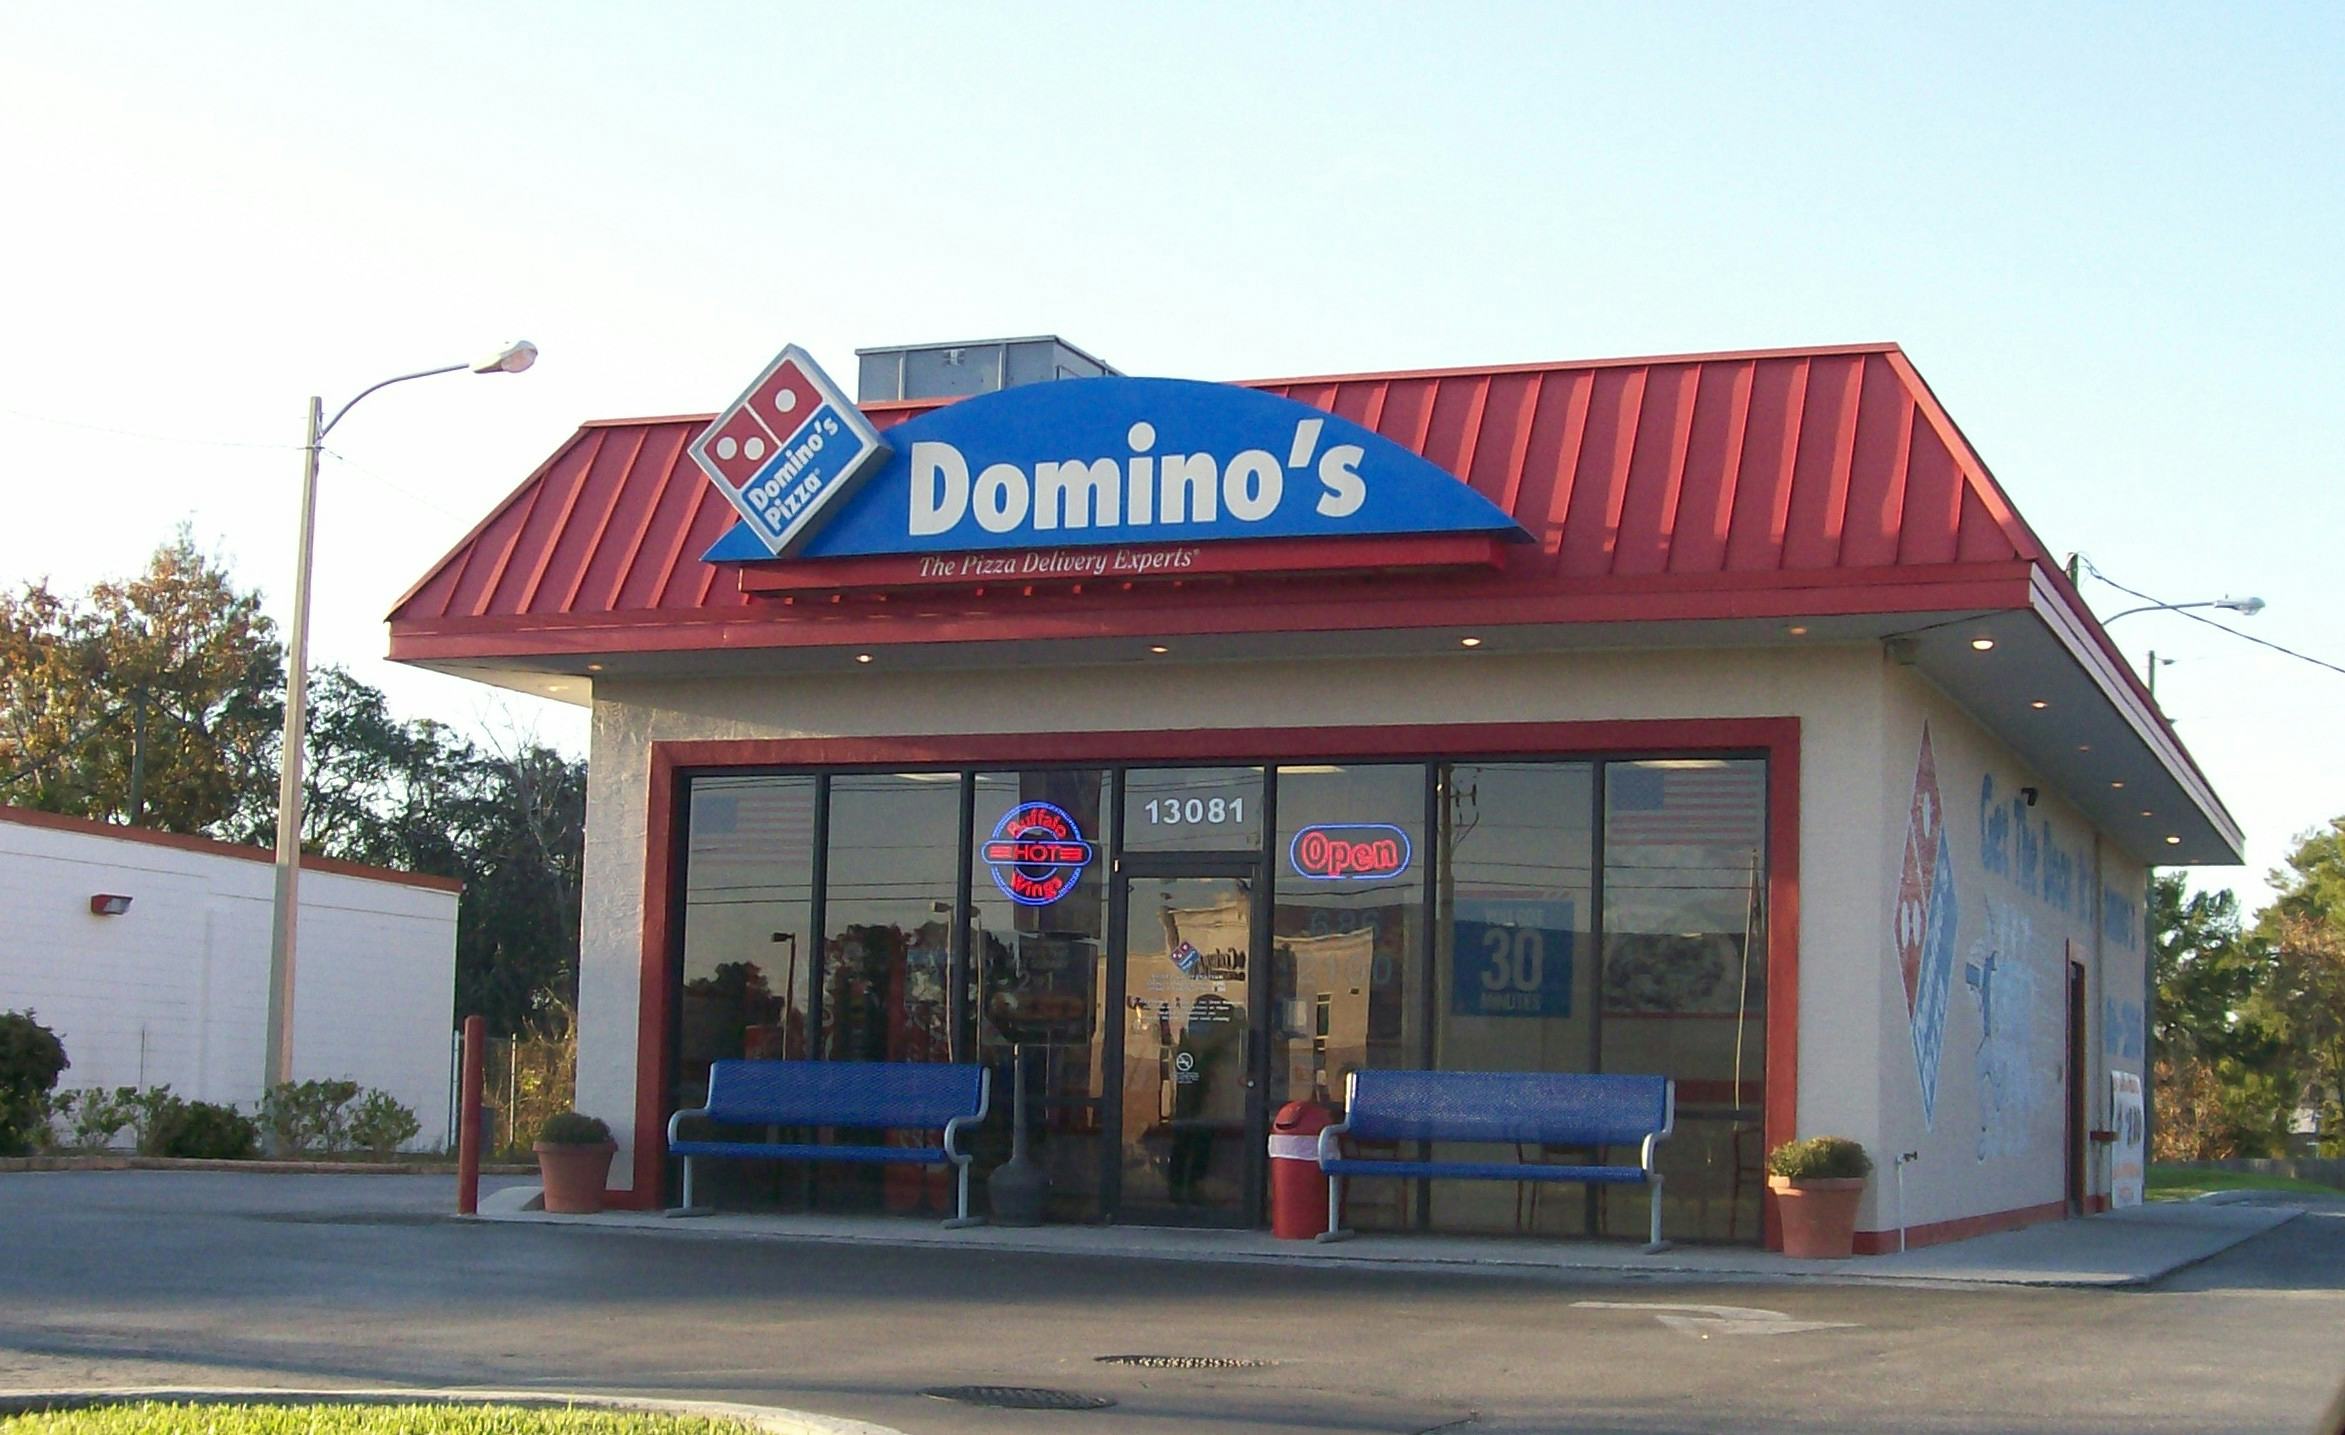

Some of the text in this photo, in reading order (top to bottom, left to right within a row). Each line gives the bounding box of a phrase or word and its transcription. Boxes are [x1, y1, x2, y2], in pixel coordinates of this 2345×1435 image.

[748, 416, 839, 512] Domino's
[908, 417, 1368, 536] Domino's
[764, 472, 823, 531] Pizza
[919, 547, 1194, 578] The Pizza Delivery Experts
[1006, 807, 1068, 838] Buffalo
[1144, 798, 1245, 825] 13081
[1014, 844, 1060, 862] HOT
[1301, 831, 1399, 877] Open
[1011, 871, 1063, 900] Wings
[1480, 927, 1544, 992] 30
